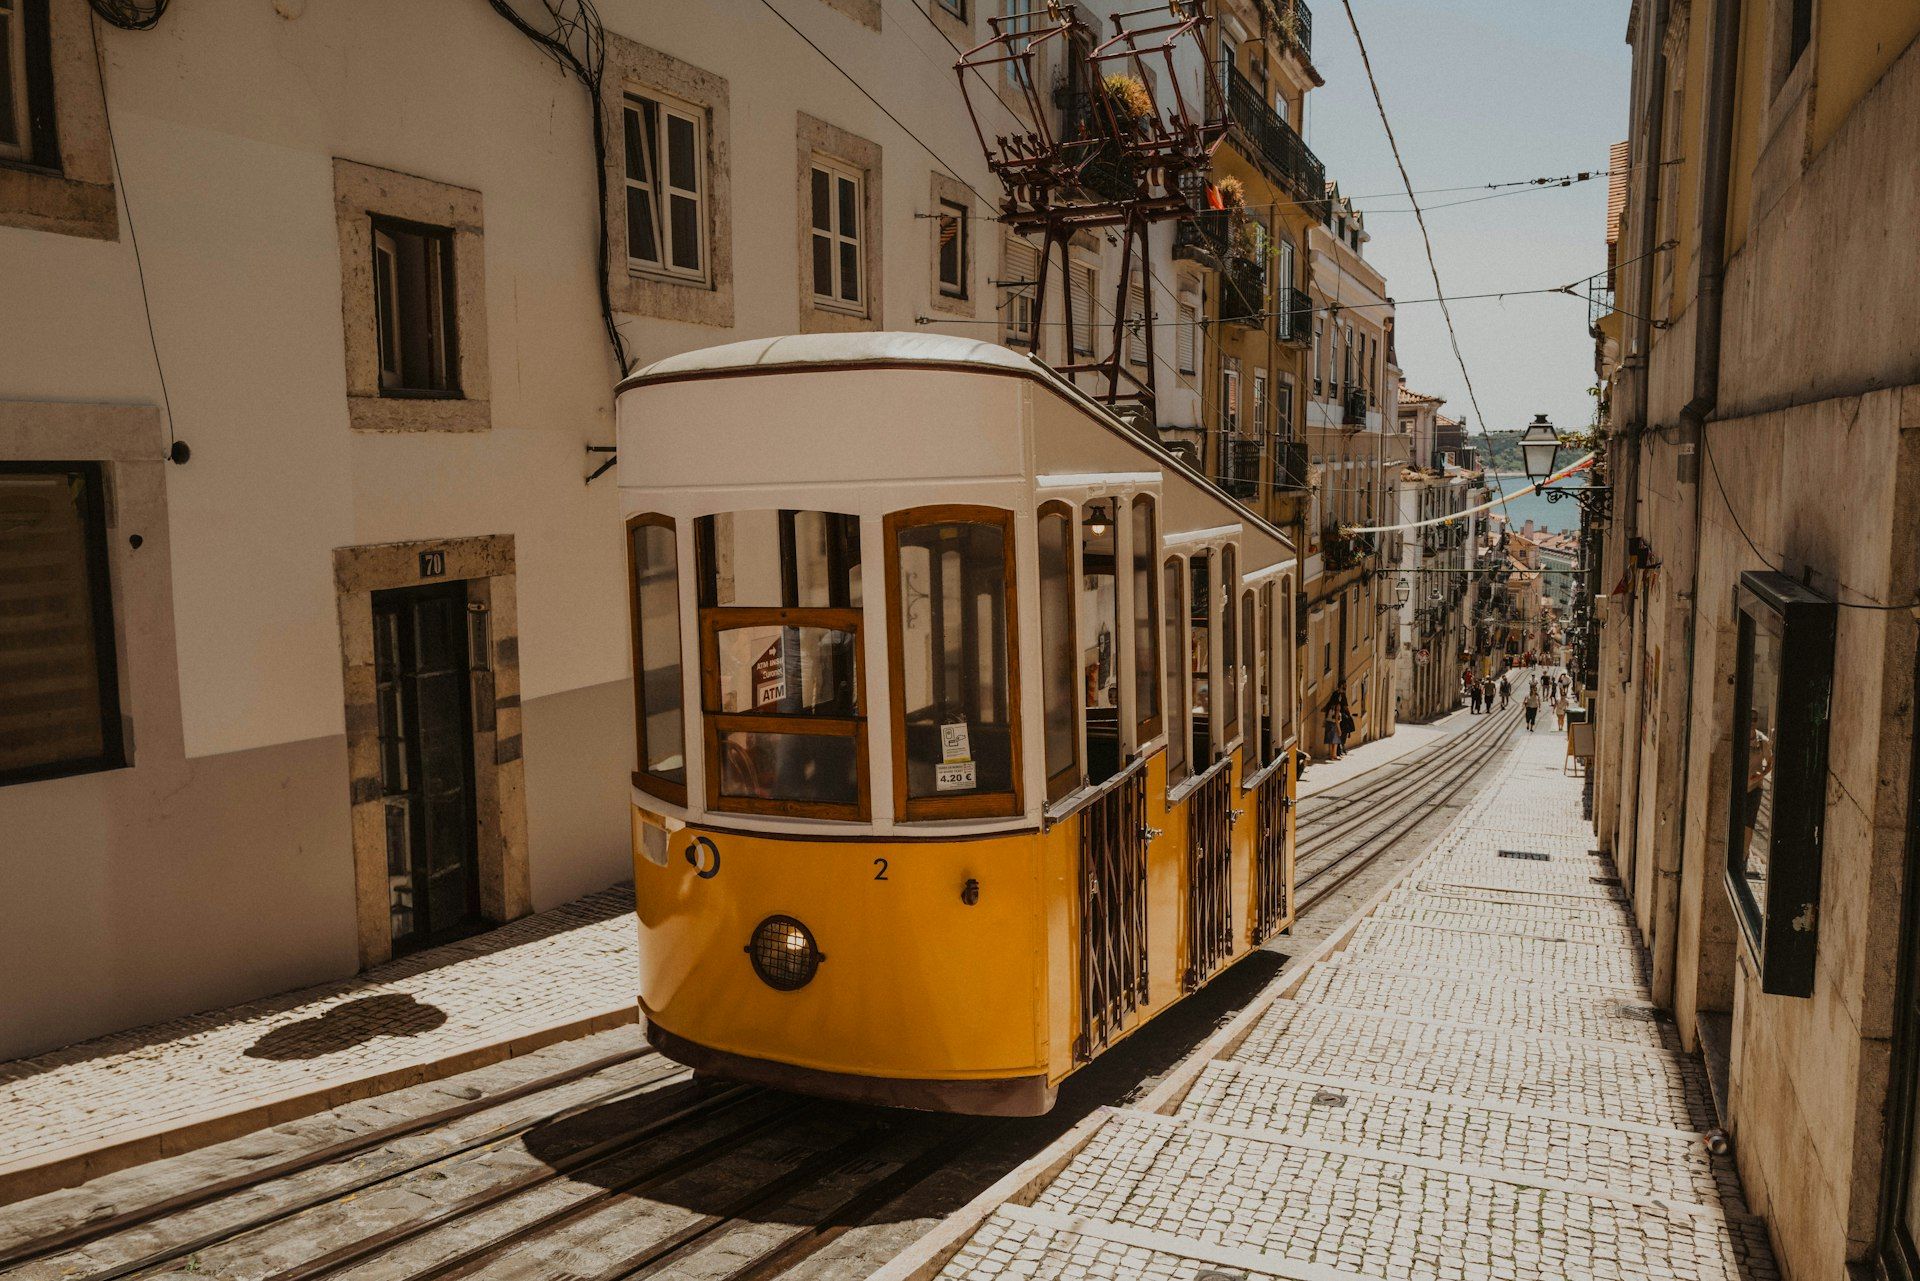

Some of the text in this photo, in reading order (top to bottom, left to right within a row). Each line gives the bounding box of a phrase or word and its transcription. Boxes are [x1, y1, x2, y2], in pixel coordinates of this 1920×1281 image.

[425, 554, 441, 576] 70
[757, 661, 769, 670] ATM
[762, 685, 784, 702] ATM
[940, 773, 972, 783] 4.20 €
[874, 858, 888, 880] 2
